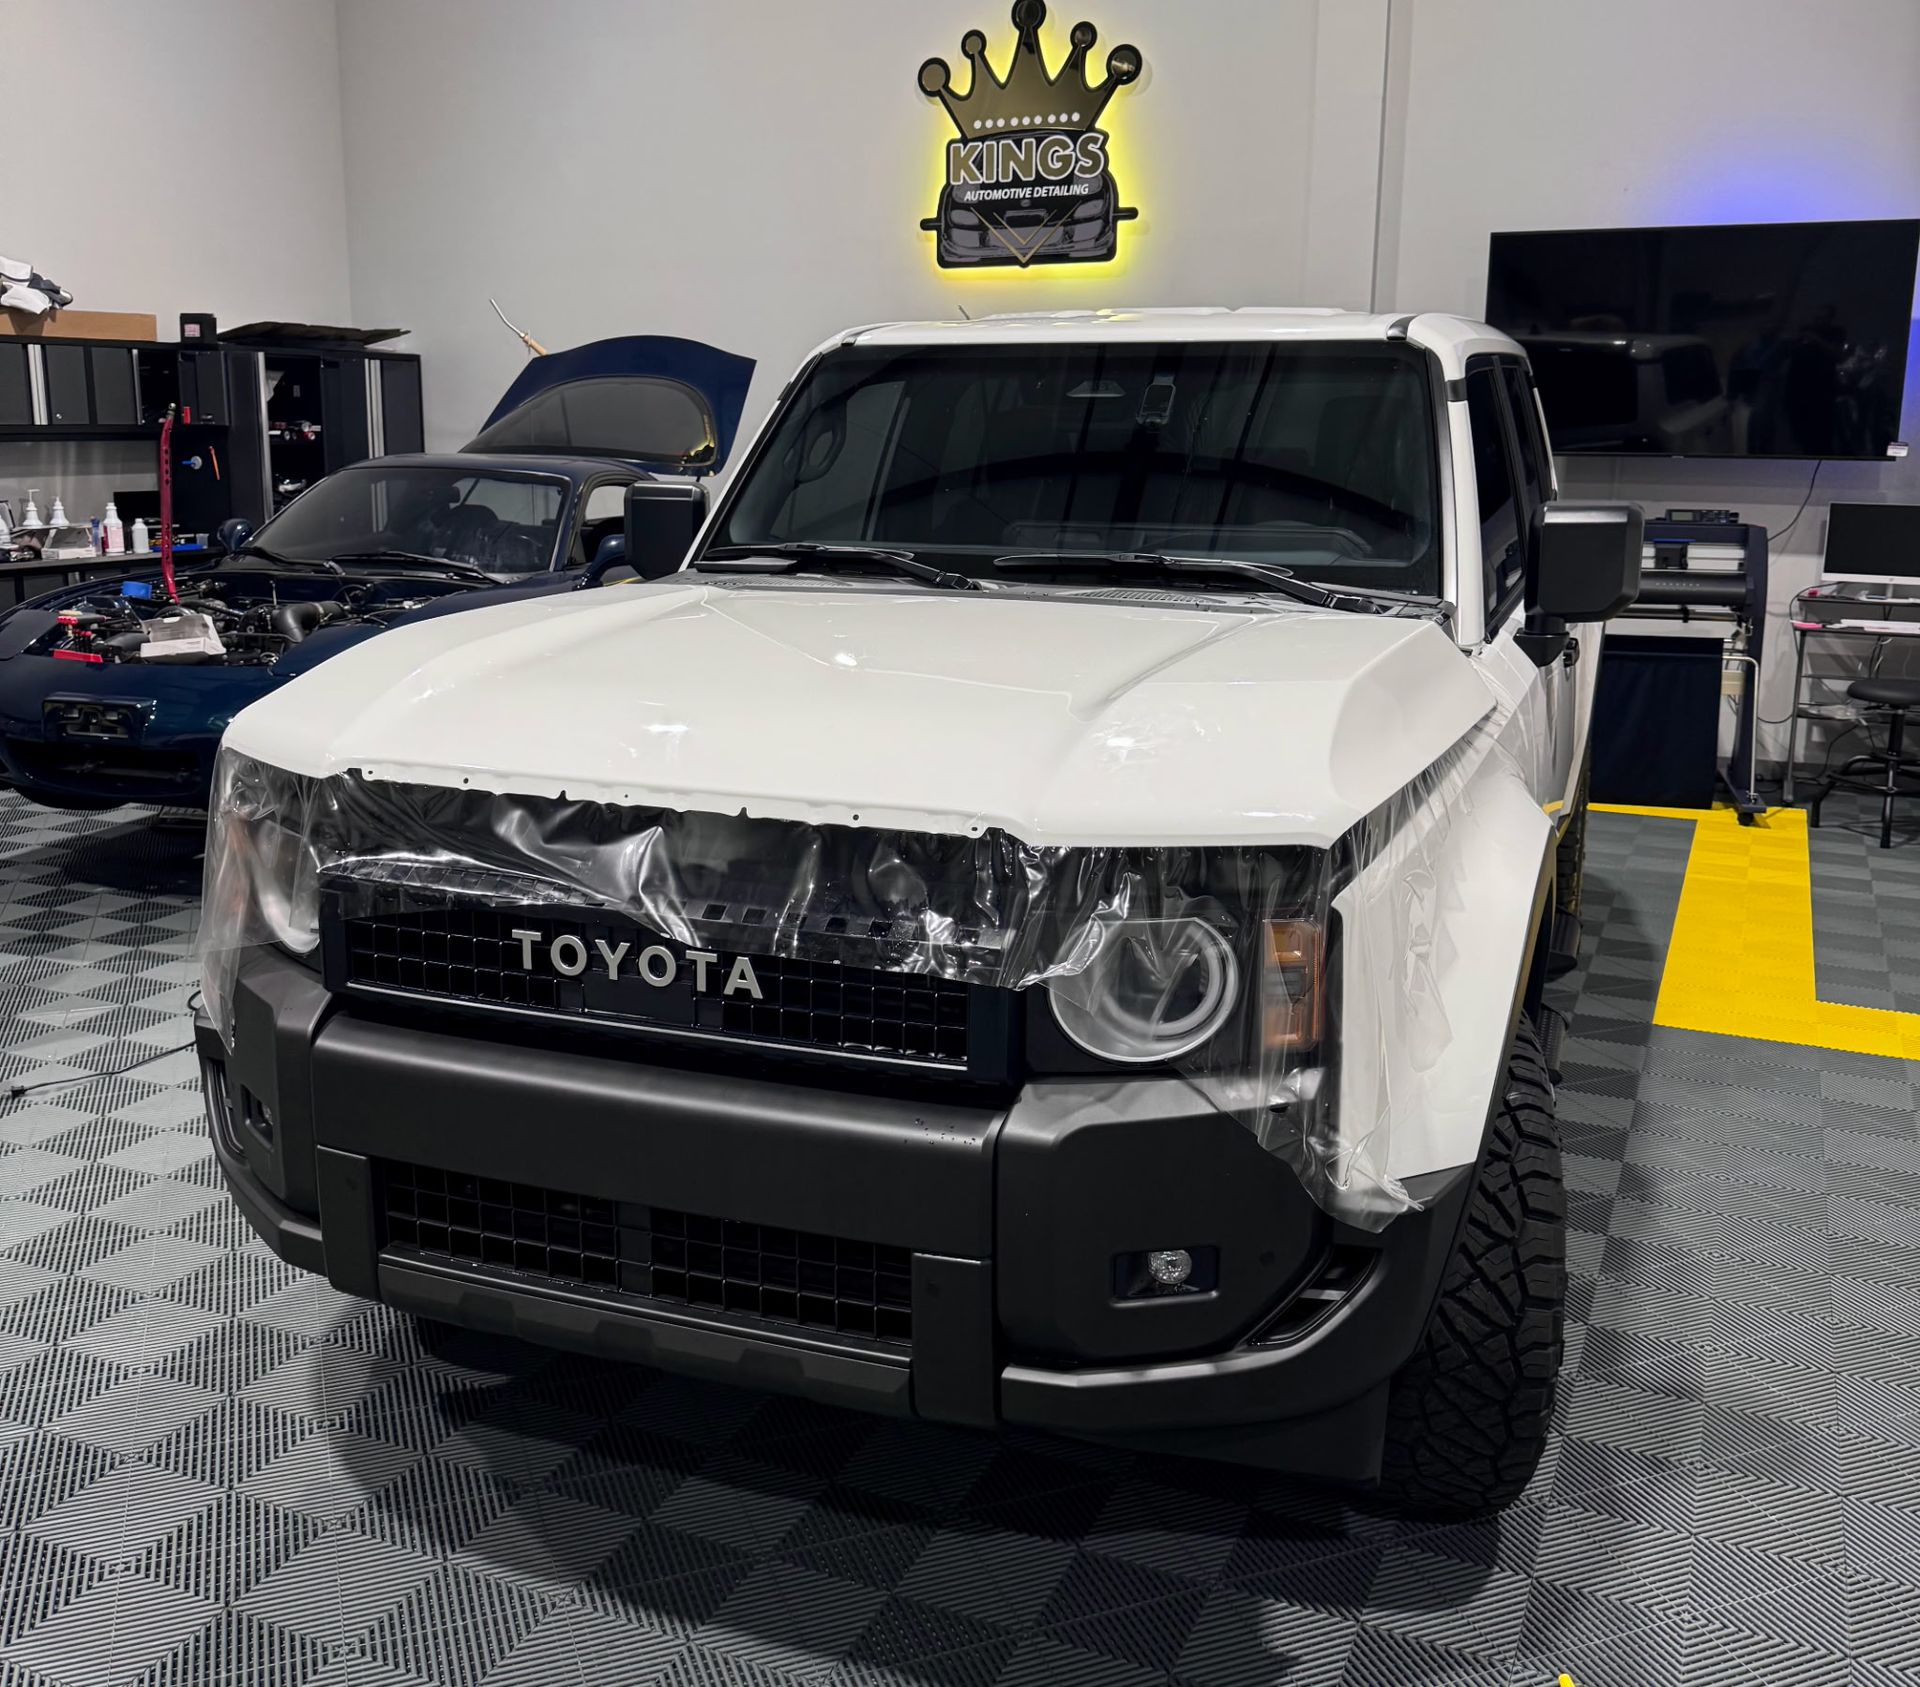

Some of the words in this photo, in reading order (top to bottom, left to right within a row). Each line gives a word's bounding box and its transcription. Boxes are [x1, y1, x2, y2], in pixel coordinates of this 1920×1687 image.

[950, 133, 1105, 185] KINGS
[964, 187, 1032, 201] AUTOMOTIVE
[1033, 184, 1089, 198] DETAILING
[511, 929, 763, 999] TOYOTA
